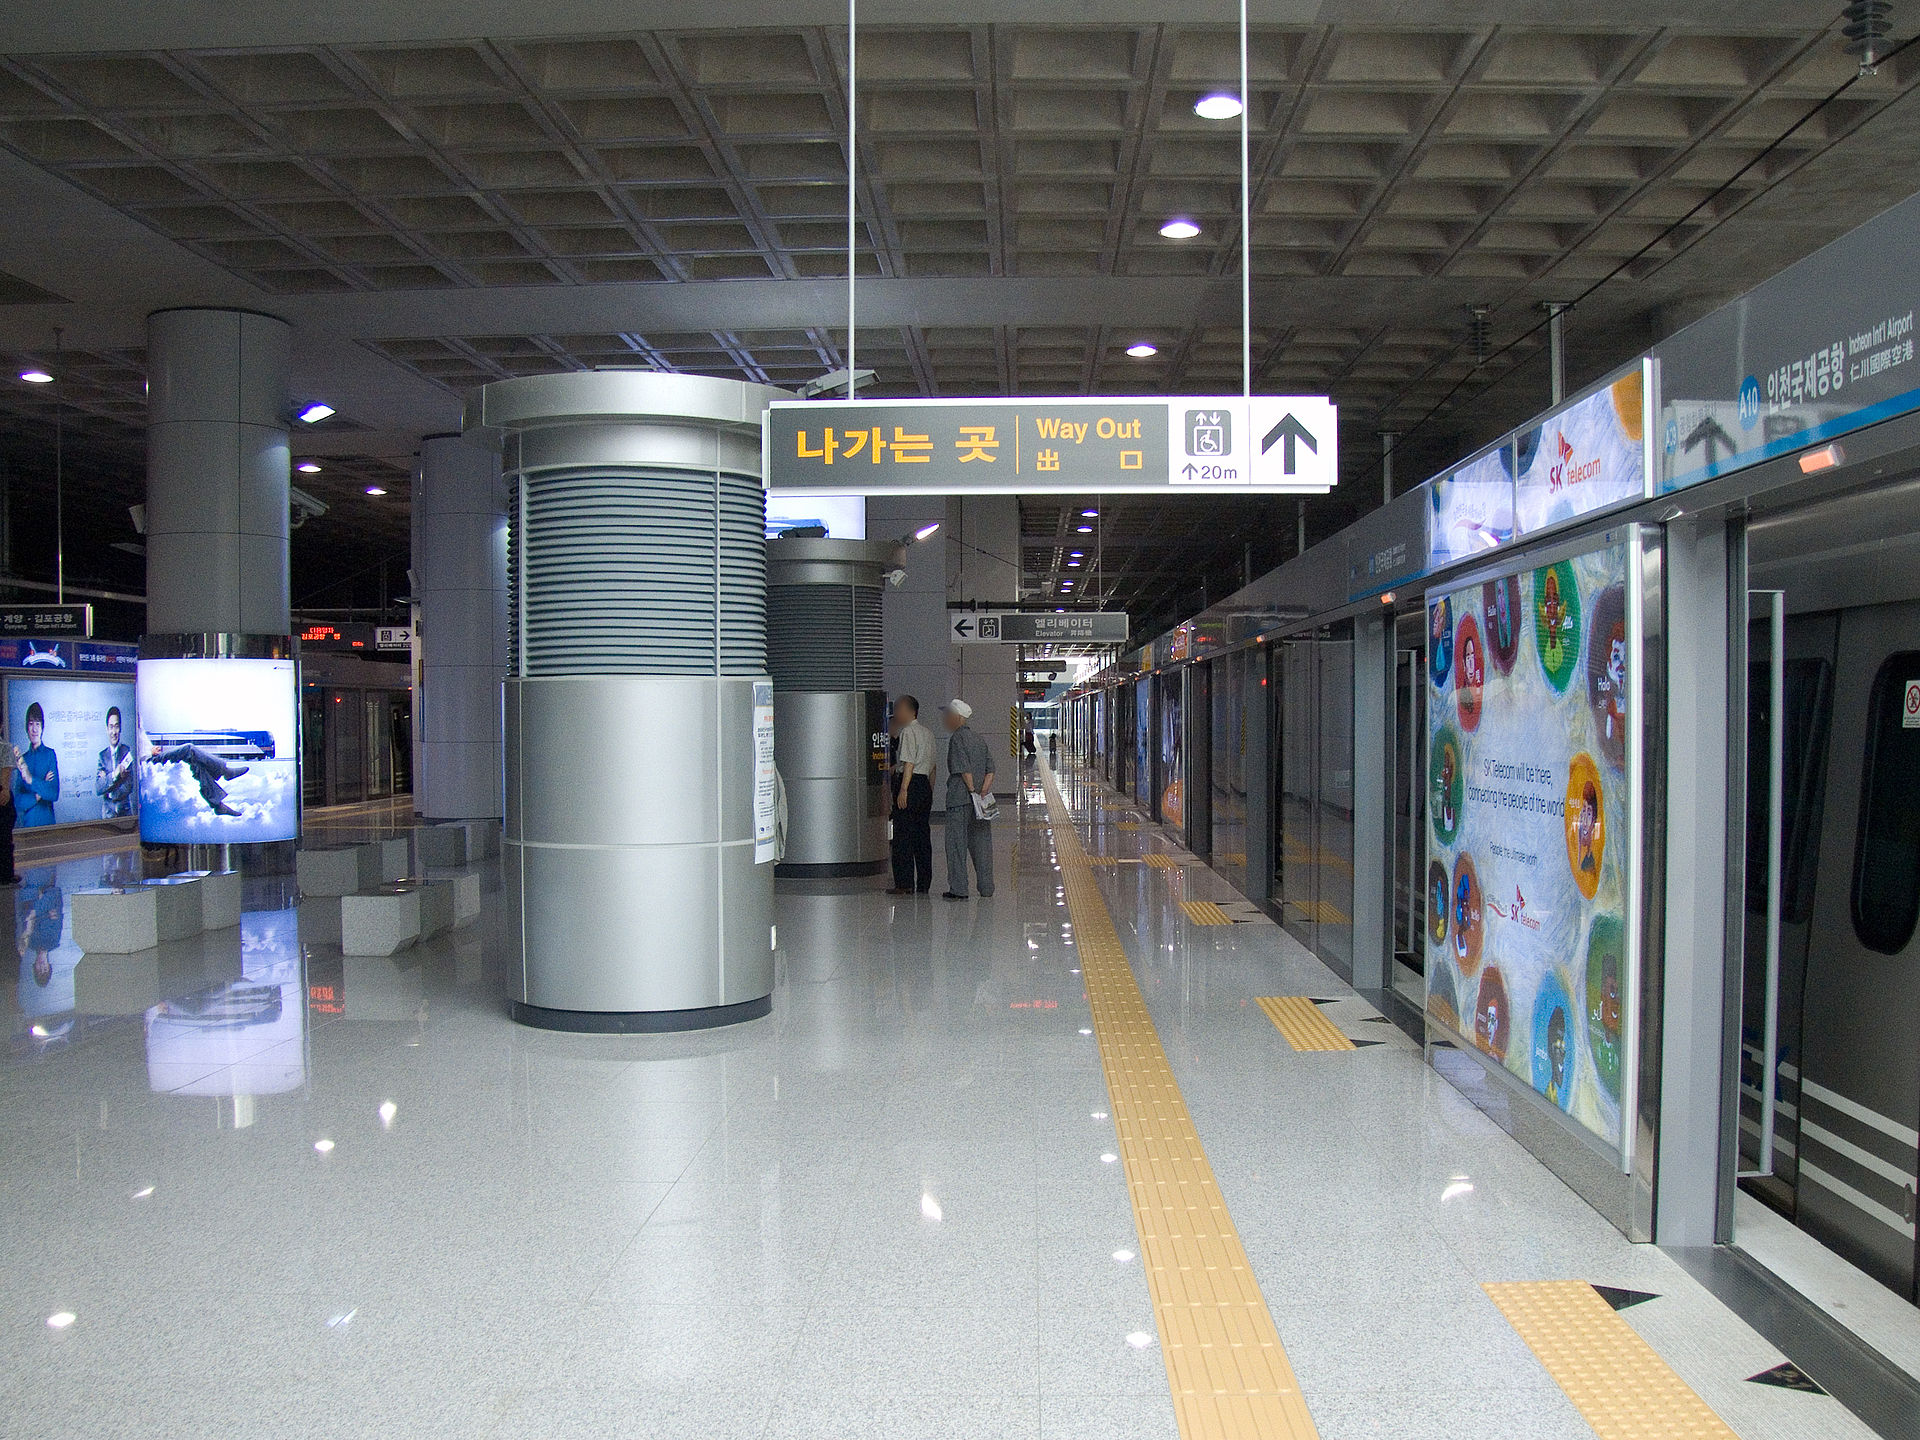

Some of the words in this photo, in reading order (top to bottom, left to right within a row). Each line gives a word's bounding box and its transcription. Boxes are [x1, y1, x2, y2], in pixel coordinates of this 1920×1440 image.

[1849, 332, 1873, 356] Incheon
[1887, 310, 1913, 341] Airport
[1850, 339, 1914, 383] 仁川國際空港
[1739, 386, 1758, 420] A10
[1767, 341, 1845, 415] 인천국제공항
[1036, 418, 1088, 444] Way
[1096, 417, 1142, 439] Out
[797, 427, 934, 464] 나가는
[955, 426, 999, 463] 곳
[1036, 449, 1060, 471] 出
[1120, 451, 1143, 470] 口
[1201, 465, 1238, 480] 20m
[1550, 463, 1563, 494] SK
[1567, 458, 1600, 487] telecom
[35, 614, 73, 623] 김포공항
[1035, 618, 1093, 628] 엘리베이터
[1483, 758, 1492, 777] SK
[1492, 760, 1515, 780] Telecom
[1467, 786, 1498, 808] connecting
[1508, 791, 1529, 813] people
[1546, 797, 1565, 817] world
[1511, 903, 1519, 923] SK
[1521, 913, 1541, 931] telecom
